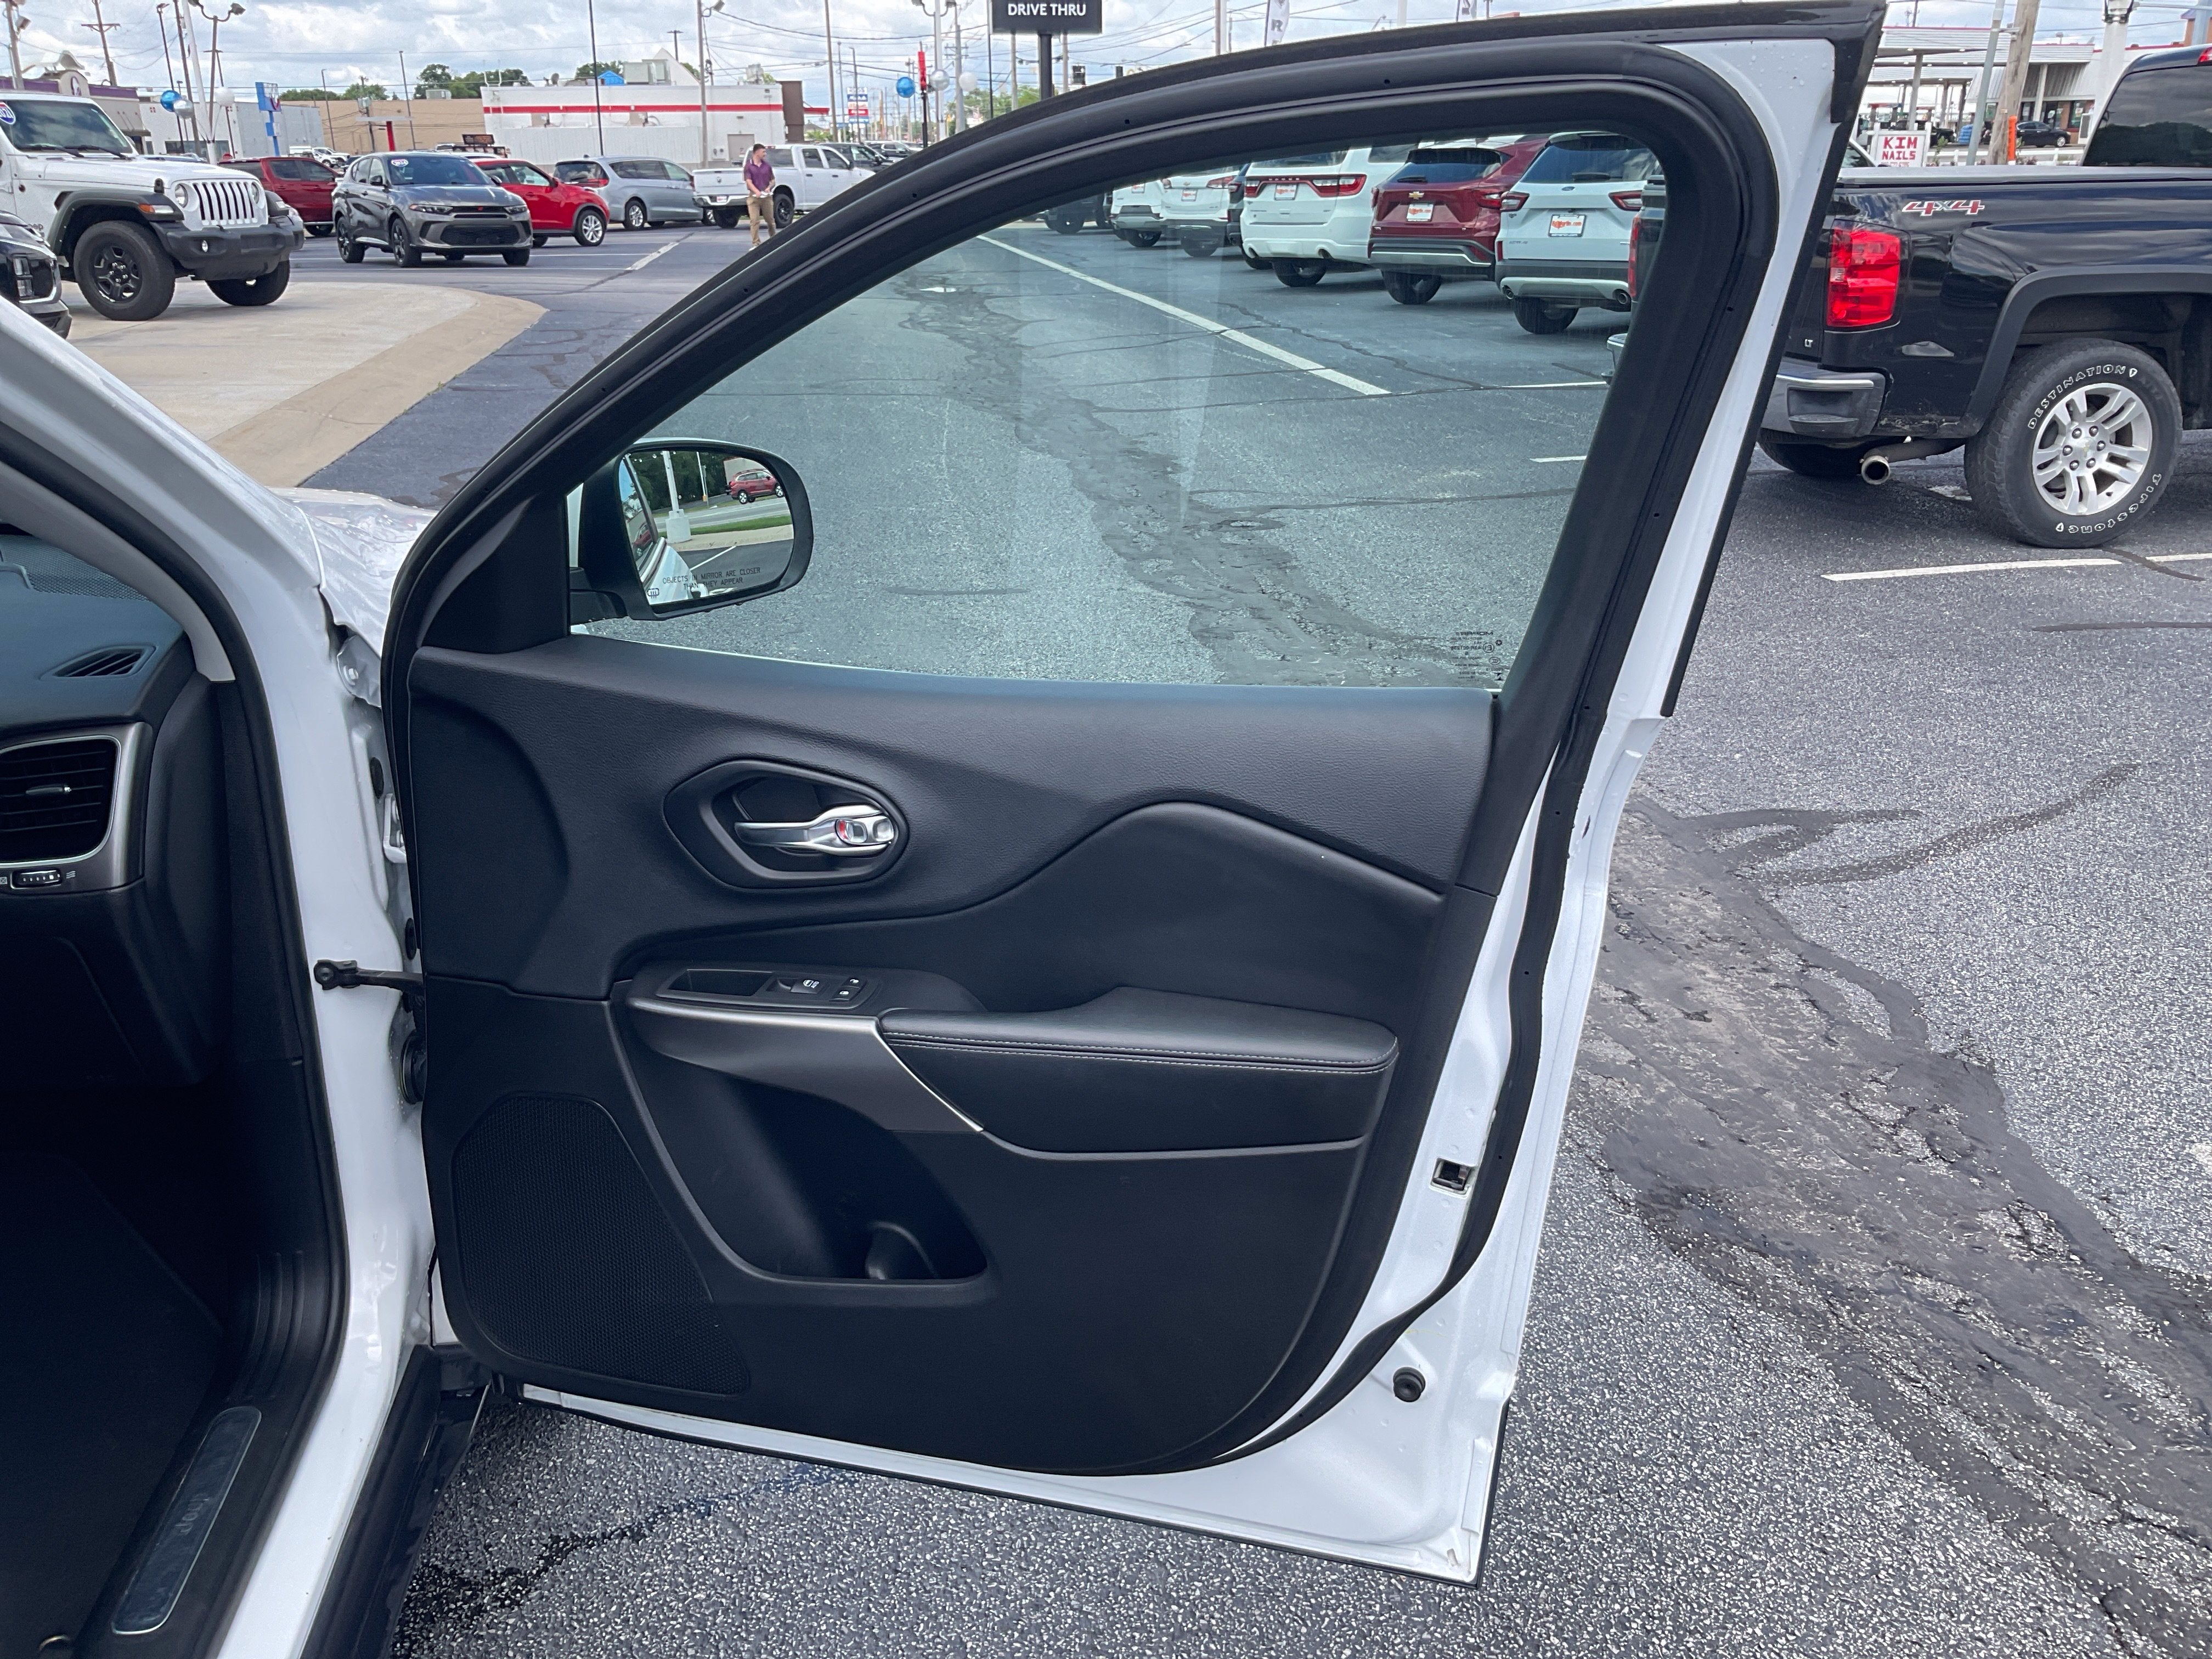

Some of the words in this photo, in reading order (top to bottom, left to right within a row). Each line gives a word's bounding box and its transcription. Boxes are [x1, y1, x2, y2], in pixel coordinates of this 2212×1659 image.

[1008, 3, 1047, 16] DRIVE
[1050, 3, 1086, 16] THRU
[1883, 137, 1918, 149] KIM
[1882, 150, 1916, 160] NAILS
[2028, 364, 2126, 430] DESTINATION
[662, 575, 689, 584] OBJECTS
[739, 567, 761, 575] CLOSER
